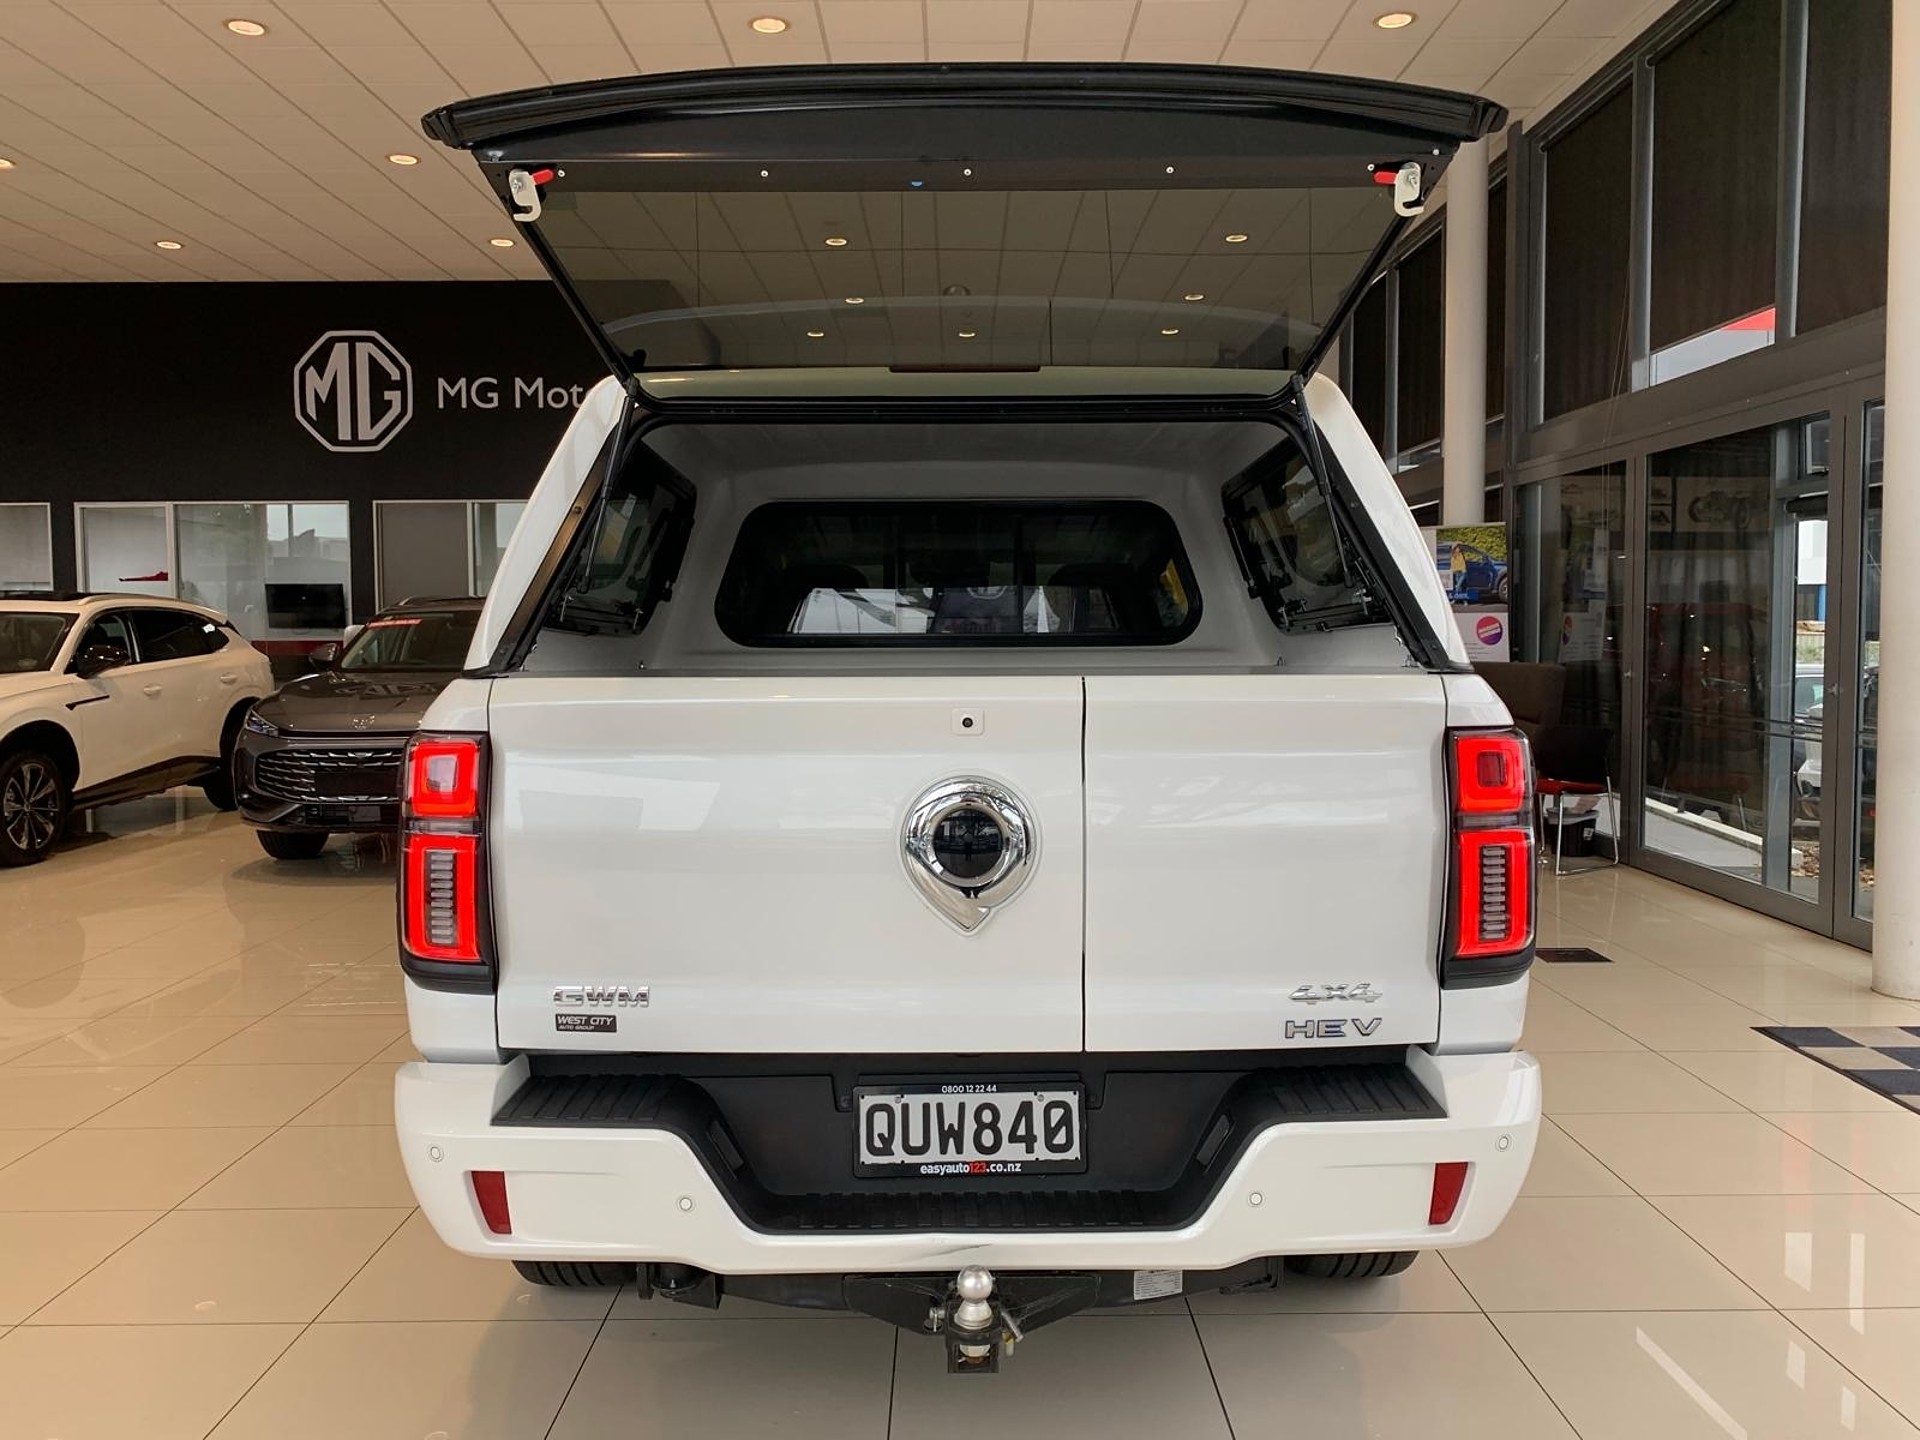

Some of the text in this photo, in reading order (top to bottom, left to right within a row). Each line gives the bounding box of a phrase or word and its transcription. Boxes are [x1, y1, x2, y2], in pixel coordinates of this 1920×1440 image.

[305, 341, 402, 441] MG
[436, 376, 590, 410] MG Mot
[553, 985, 650, 1008] GWM
[557, 1015, 614, 1026] WEST CITY
[1285, 1017, 1383, 1039] HEV
[941, 1084, 997, 1094] 0800 12 22 44
[865, 1099, 1075, 1157] QUW840
[919, 1161, 1022, 1176] easyauto123.co.nz
